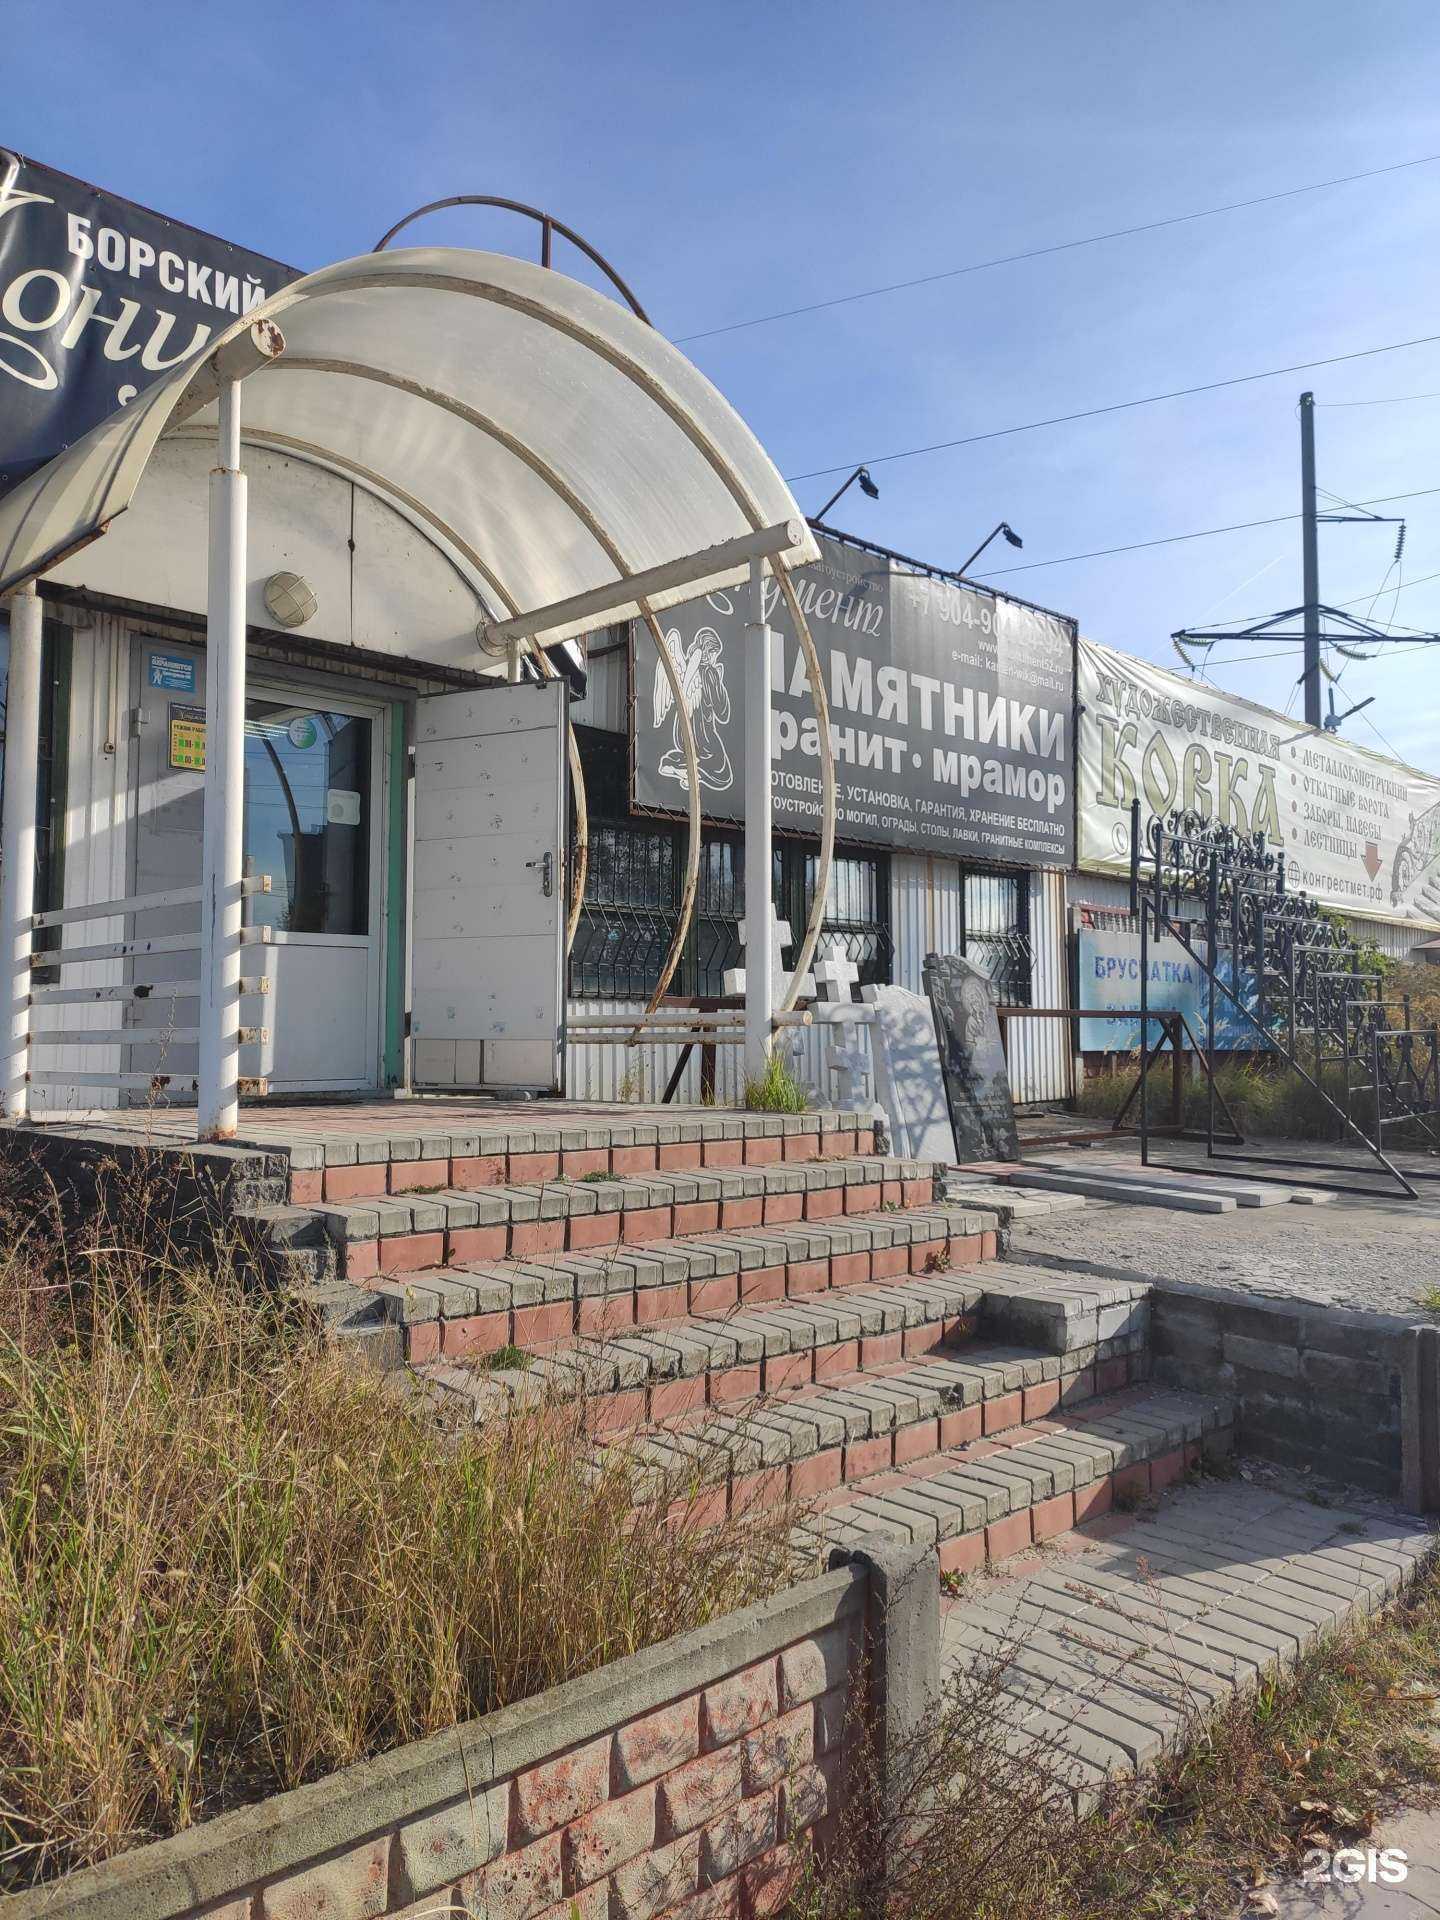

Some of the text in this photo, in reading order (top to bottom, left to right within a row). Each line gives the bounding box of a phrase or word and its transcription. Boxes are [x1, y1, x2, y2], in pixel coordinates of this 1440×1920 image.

[67, 212, 266, 317] БОРСКИЙ
[952, 650, 983, 671] e-mail:
[771, 708, 1065, 814] ранит мрамор
[1096, 713, 1284, 846] КОВКА
[847, 785, 912, 813] УСТАНОВКА,
[915, 798, 967, 821] ГАРАНТИЯ,
[970, 809, 1016, 829] ХРАНЕНИЕ
[1017, 816, 1065, 837] БЕСПЛАТНО
[1303, 775, 1390, 819] ОТКАТНЫЕ ВОРОТА
[846, 809, 880, 827] МОГИЛ,
[881, 816, 919, 834] ОГРАДЫ,
[952, 828, 980, 844] ЛАВКИ,
[981, 832, 1024, 849] ГРАНИТНЫЕ
[1024, 839, 1065, 855] КОМПЛЕКСЫ
[1303, 829, 1358, 859] ЛЕСТНИЦЫ
[1345, 815, 1382, 840] НАВЕСЫ
[1094, 955, 1193, 984] БРУСАТКА
